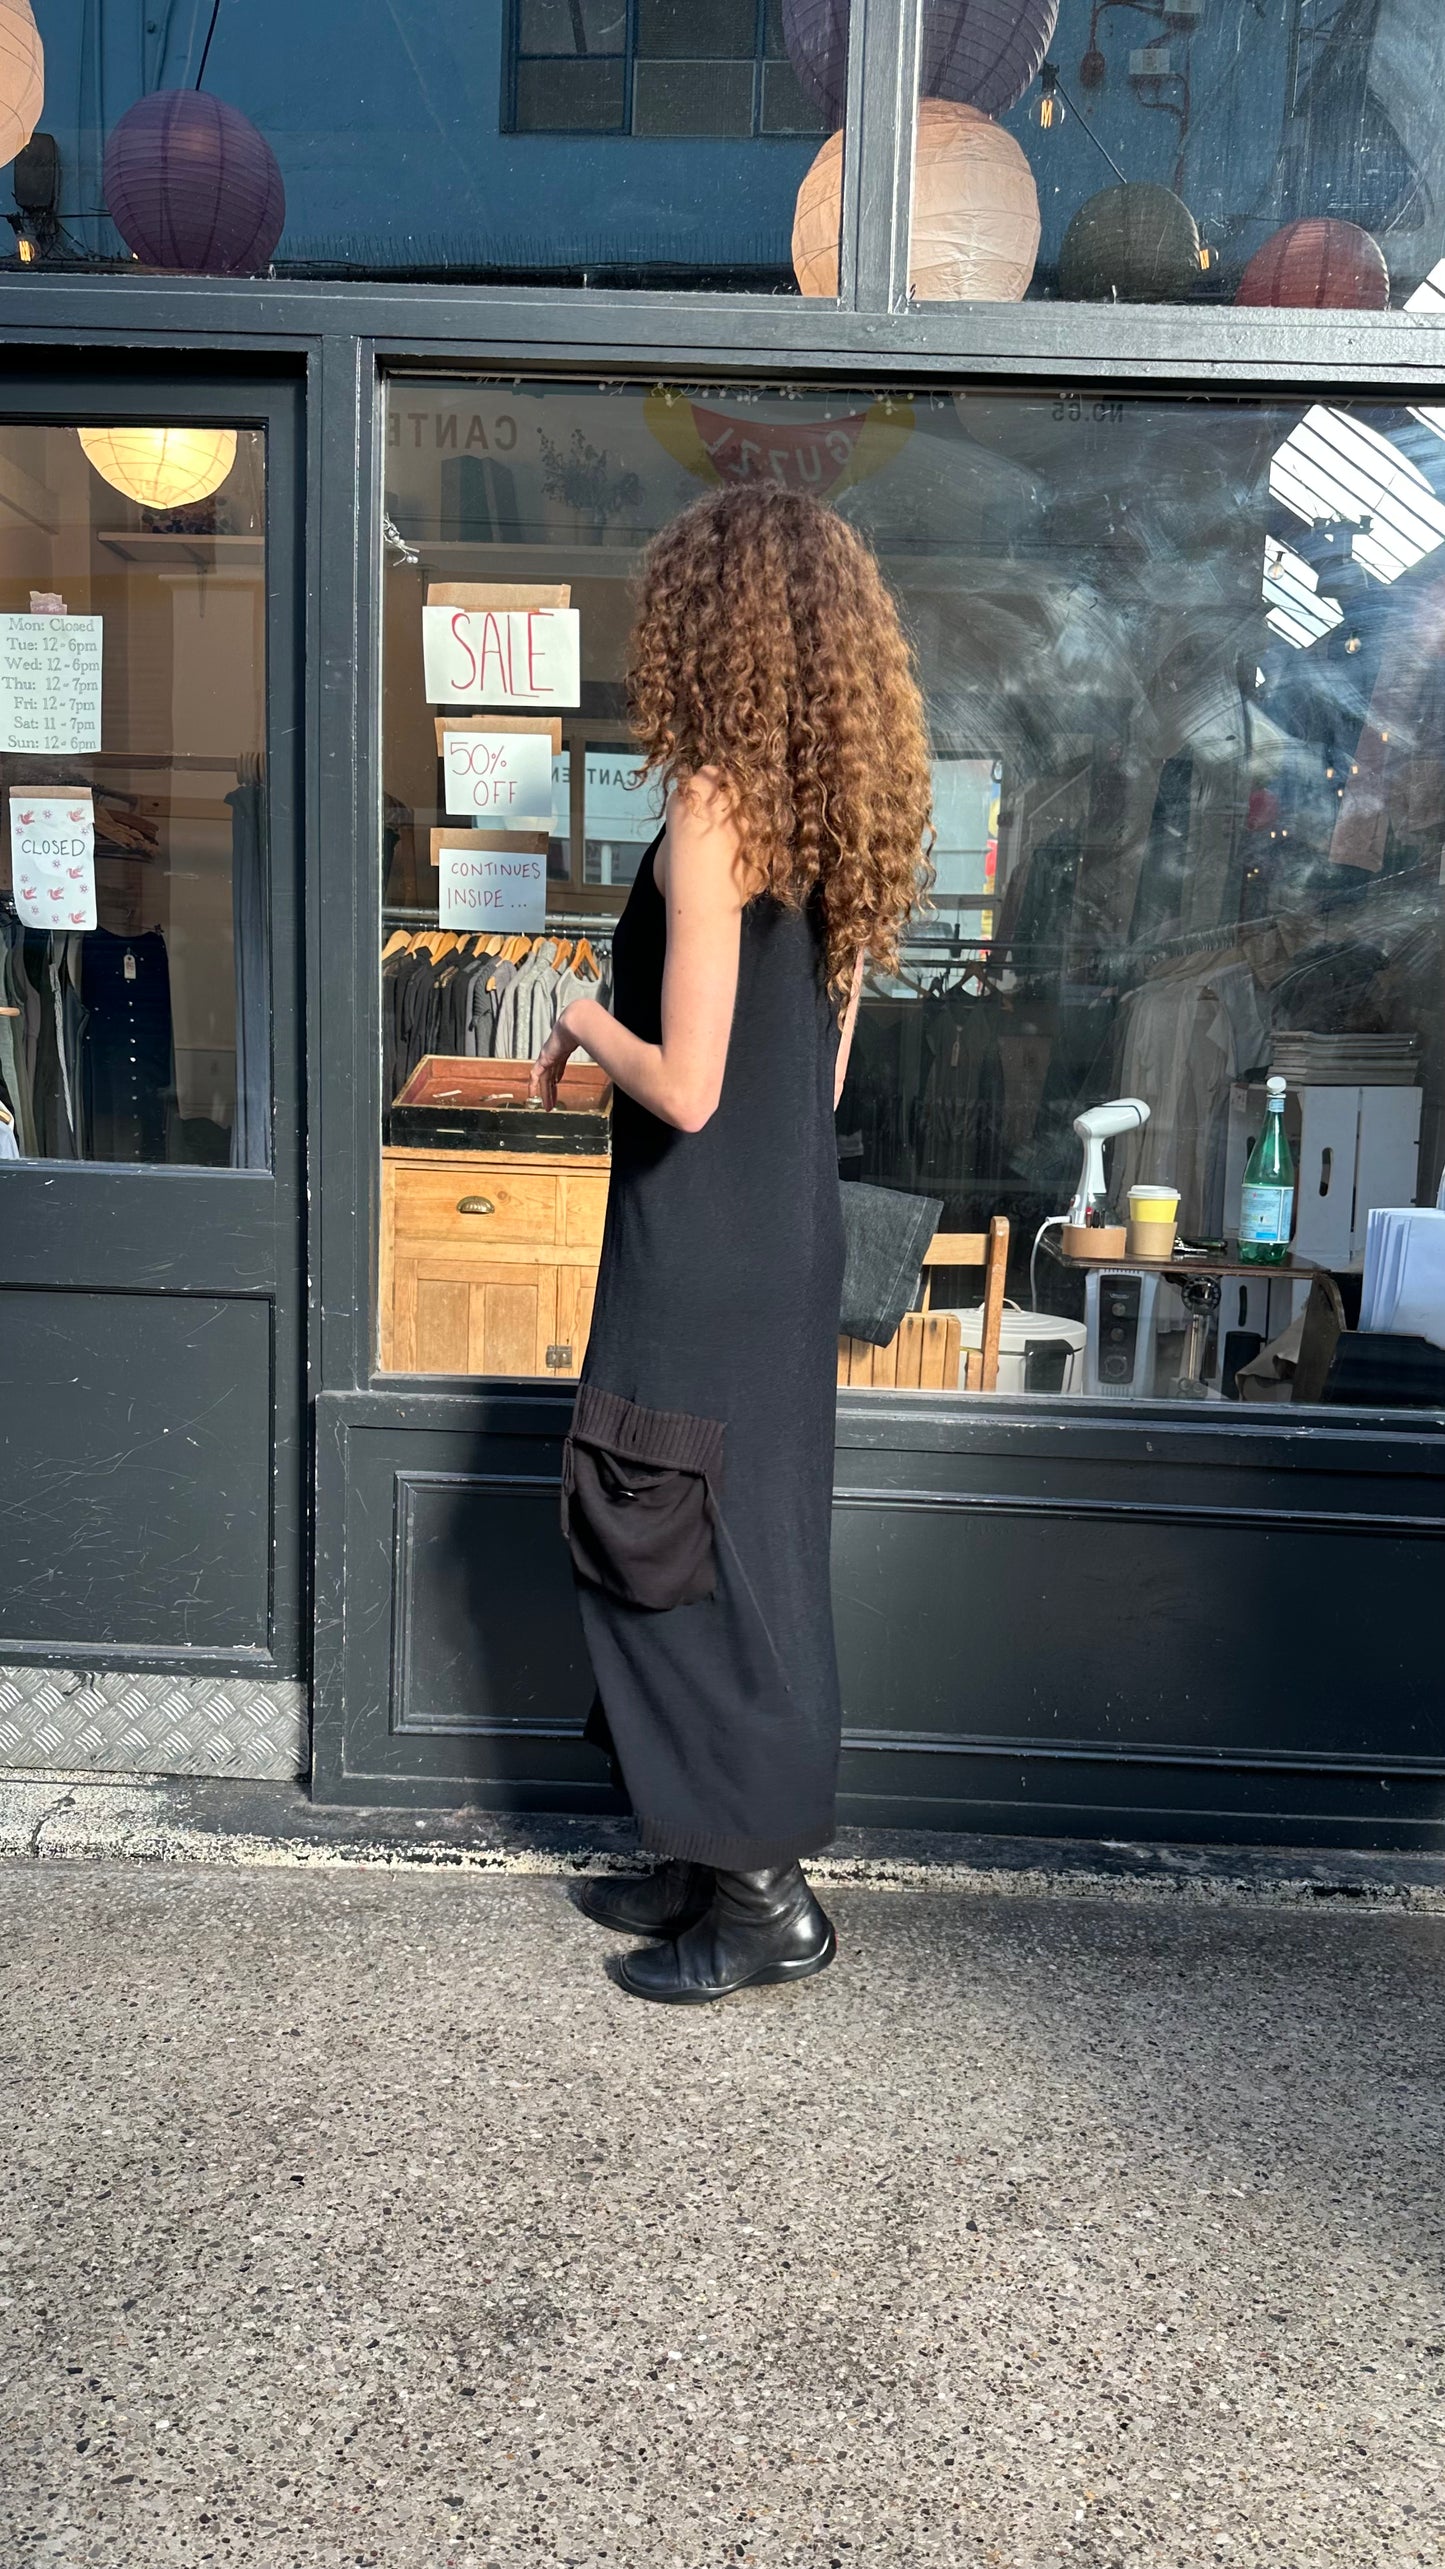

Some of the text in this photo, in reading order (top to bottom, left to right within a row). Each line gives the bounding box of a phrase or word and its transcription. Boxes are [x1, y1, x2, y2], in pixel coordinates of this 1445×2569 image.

[8, 617, 95, 632] Mon: Closed
[6, 637, 38, 651] Tue:
[451, 612, 554, 698] SALE
[4, 656, 42, 671] Wed:
[1, 676, 36, 690] Thu:
[14, 696, 37, 710] Fri:
[14, 716, 38, 729] Sat:
[8, 735, 39, 749] Sun:
[450, 742, 507, 776] 50%
[473, 780, 518, 807] OFF
[21, 839, 86, 857] CLOSED
[451, 862, 541, 879] CONTINUES
